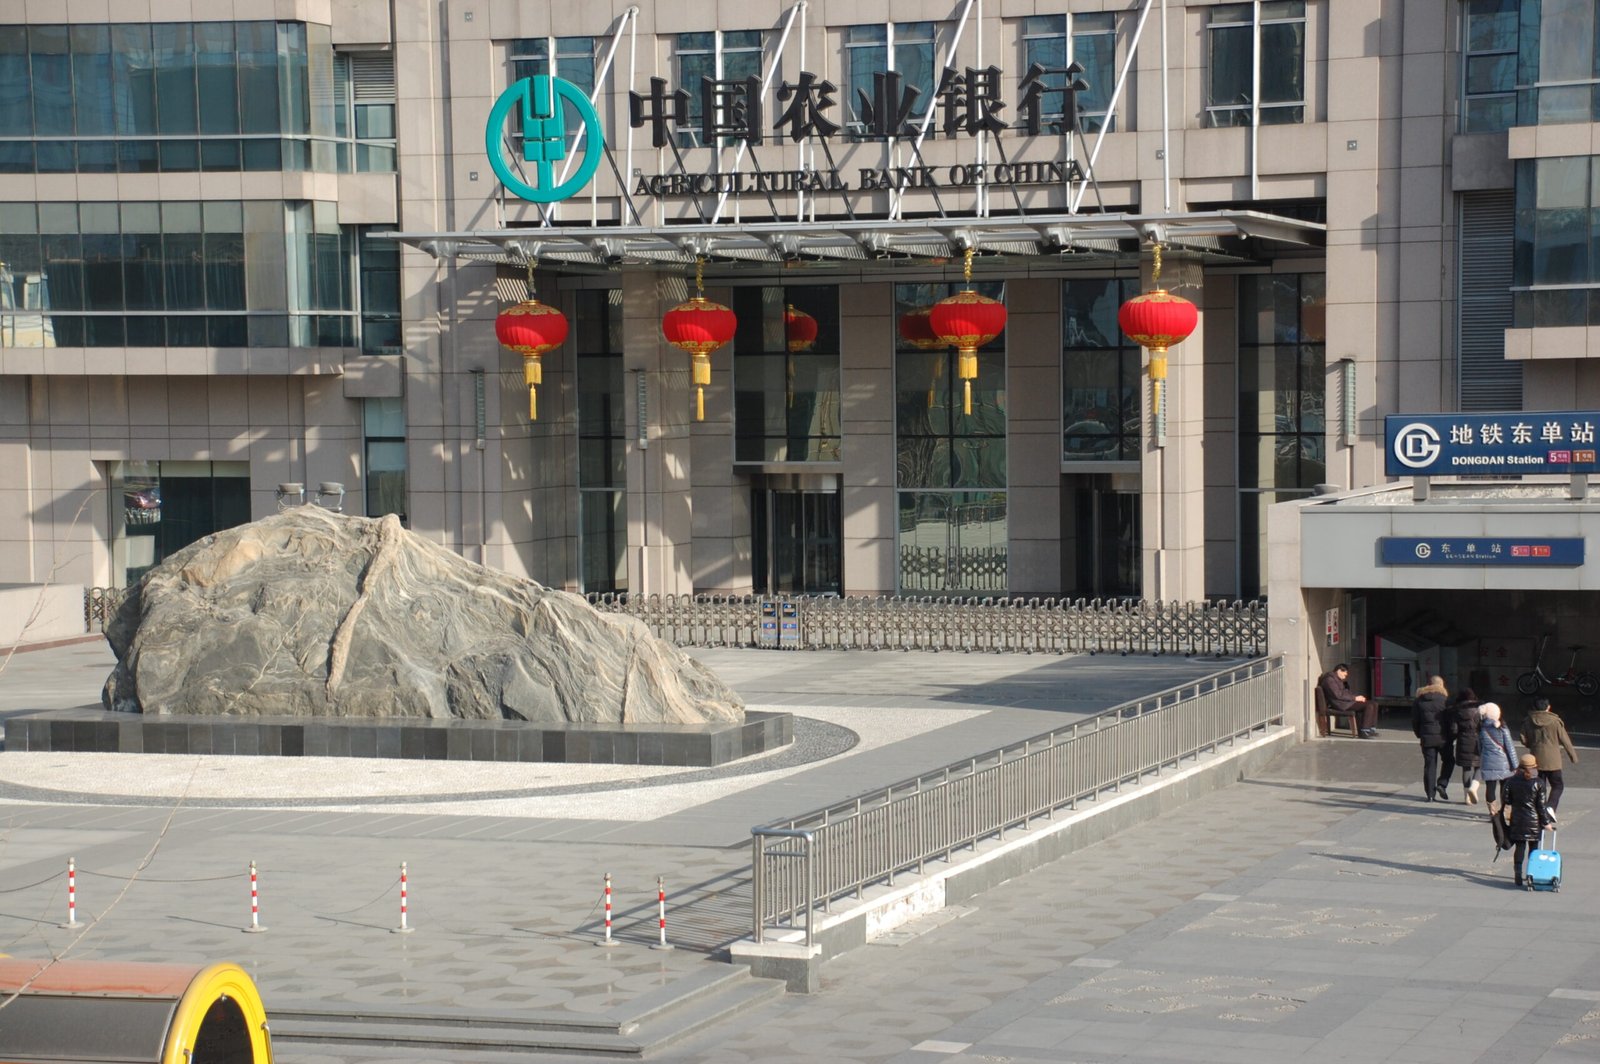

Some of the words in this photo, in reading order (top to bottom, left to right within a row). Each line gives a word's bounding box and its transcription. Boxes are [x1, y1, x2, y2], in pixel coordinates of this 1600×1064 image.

[629, 62, 1090, 148] 中国农业银行
[633, 168, 848, 196] AGRICULTURAL
[859, 166, 940, 191] BANK
[949, 163, 985, 186] OF
[994, 159, 1087, 184] CHINA
[1450, 422, 1594, 444] 地铁东单站
[1452, 456, 1504, 465] DONGDAN
[1507, 455, 1544, 465] Station
[1441, 543, 1501, 553] 东单站
